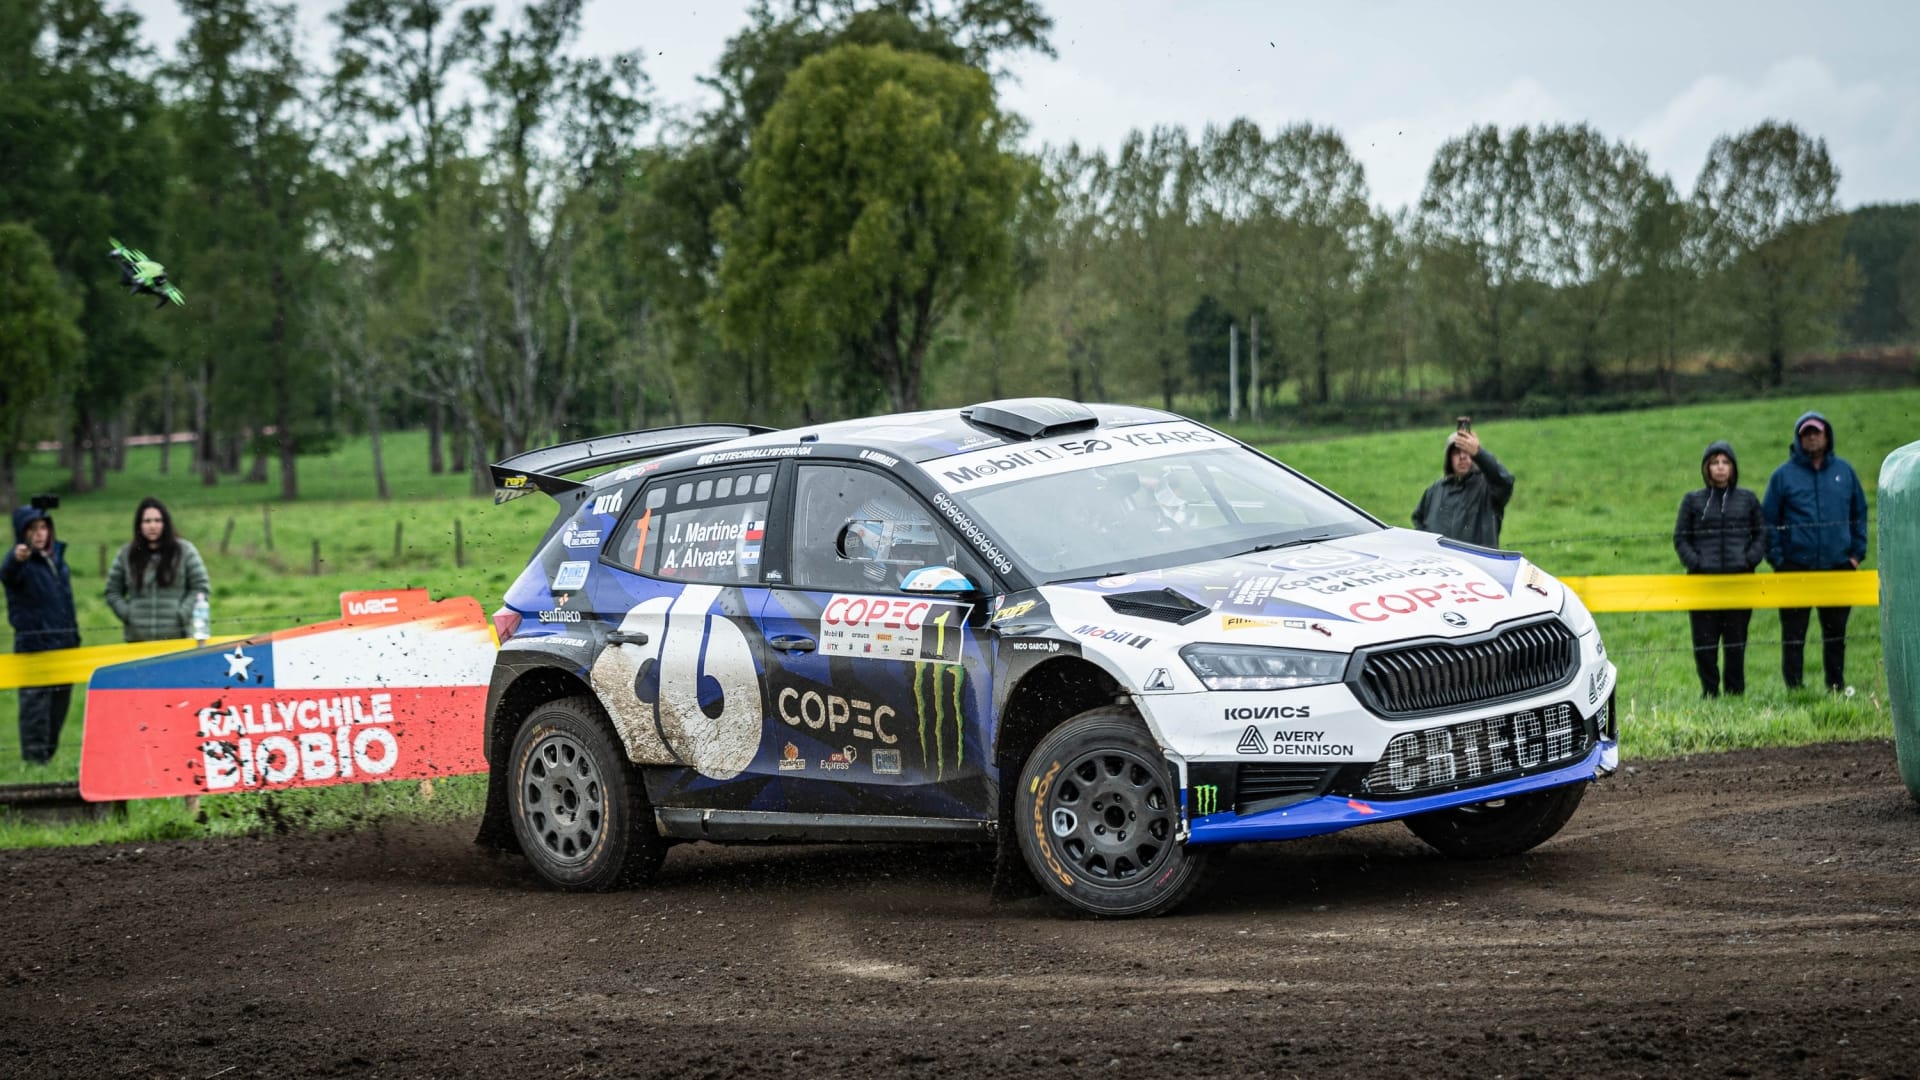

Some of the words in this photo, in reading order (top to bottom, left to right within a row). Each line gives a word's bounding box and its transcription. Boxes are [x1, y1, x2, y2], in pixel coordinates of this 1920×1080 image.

[943, 452, 1033, 485] Mobil
[1113, 430, 1217, 448] YEARS
[634, 508, 652, 572] 1
[669, 523, 682, 544] J.
[685, 519, 746, 543] Martínez
[663, 549, 679, 569] A.
[681, 542, 736, 568] Álvarez
[348, 597, 399, 616] WRC
[825, 597, 929, 631] COPEC
[1349, 581, 1505, 622] COPEC
[538, 607, 581, 623] senfineco
[933, 610, 951, 656] 1
[1072, 624, 1133, 643] Mobil
[1013, 642, 1027, 650] NICO
[1028, 642, 1049, 650] GARCIA
[198, 693, 395, 738] RALLYCHILE
[778, 687, 899, 744] COPEC
[1225, 706, 1310, 721] KOVACS
[1273, 731, 1325, 742] AVERY
[1273, 744, 1354, 756] DENNISON
[820, 759, 850, 772] Express
